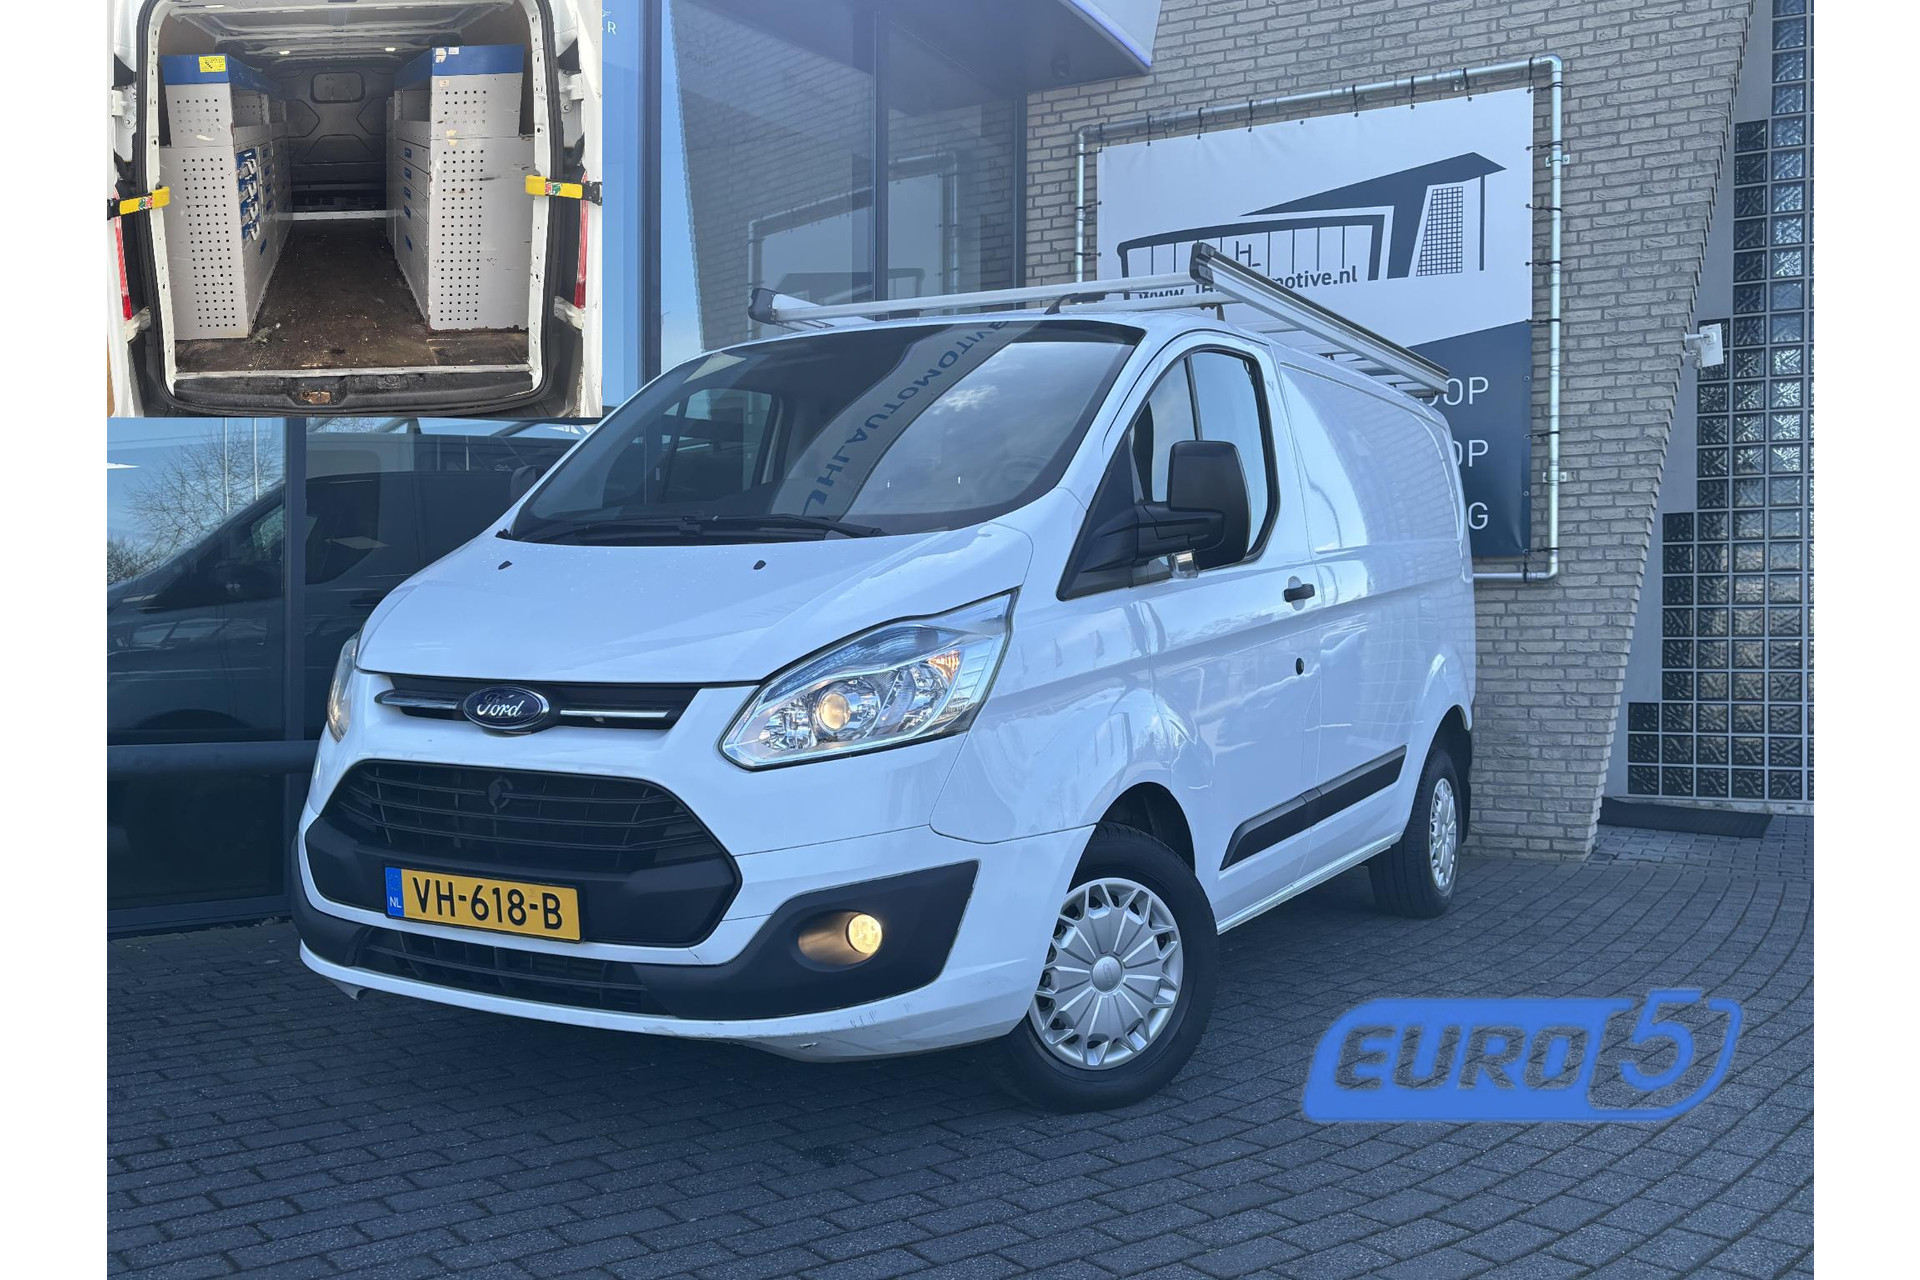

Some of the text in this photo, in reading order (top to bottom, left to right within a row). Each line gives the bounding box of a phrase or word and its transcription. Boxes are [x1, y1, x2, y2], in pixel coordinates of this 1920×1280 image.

[1426, 376, 1489, 406] OP
[476, 693, 525, 717] Ford
[389, 876, 562, 930] NL VH-618-B
